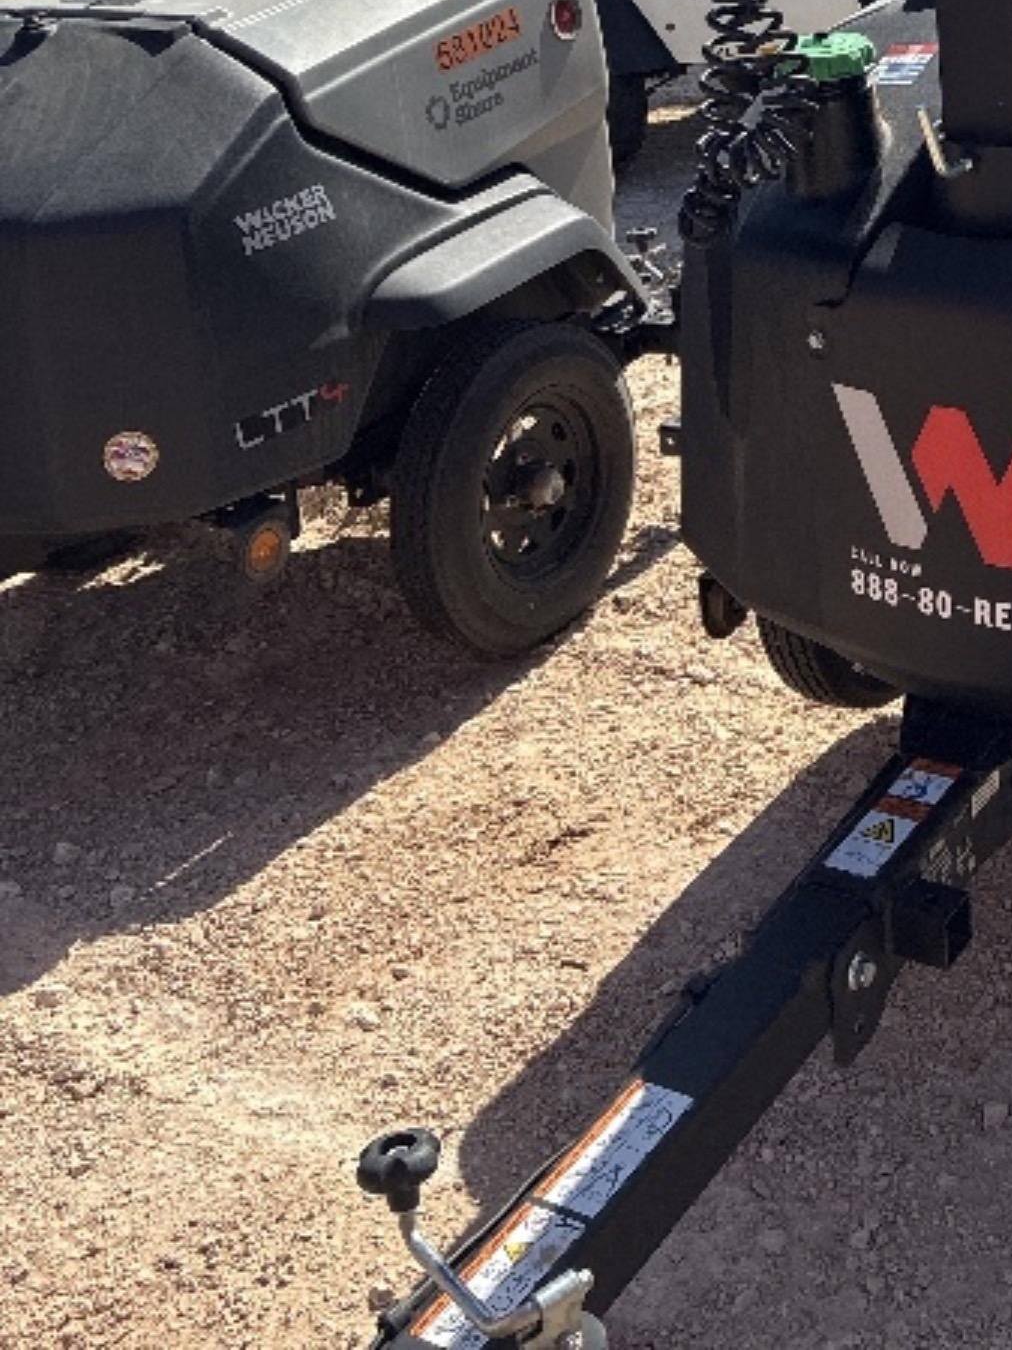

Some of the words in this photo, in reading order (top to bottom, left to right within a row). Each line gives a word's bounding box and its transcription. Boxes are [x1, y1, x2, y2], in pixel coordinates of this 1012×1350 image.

[233, 183, 328, 234] WACKER
[242, 200, 337, 256] NEUSON
[234, 382, 349, 450] LTT4
